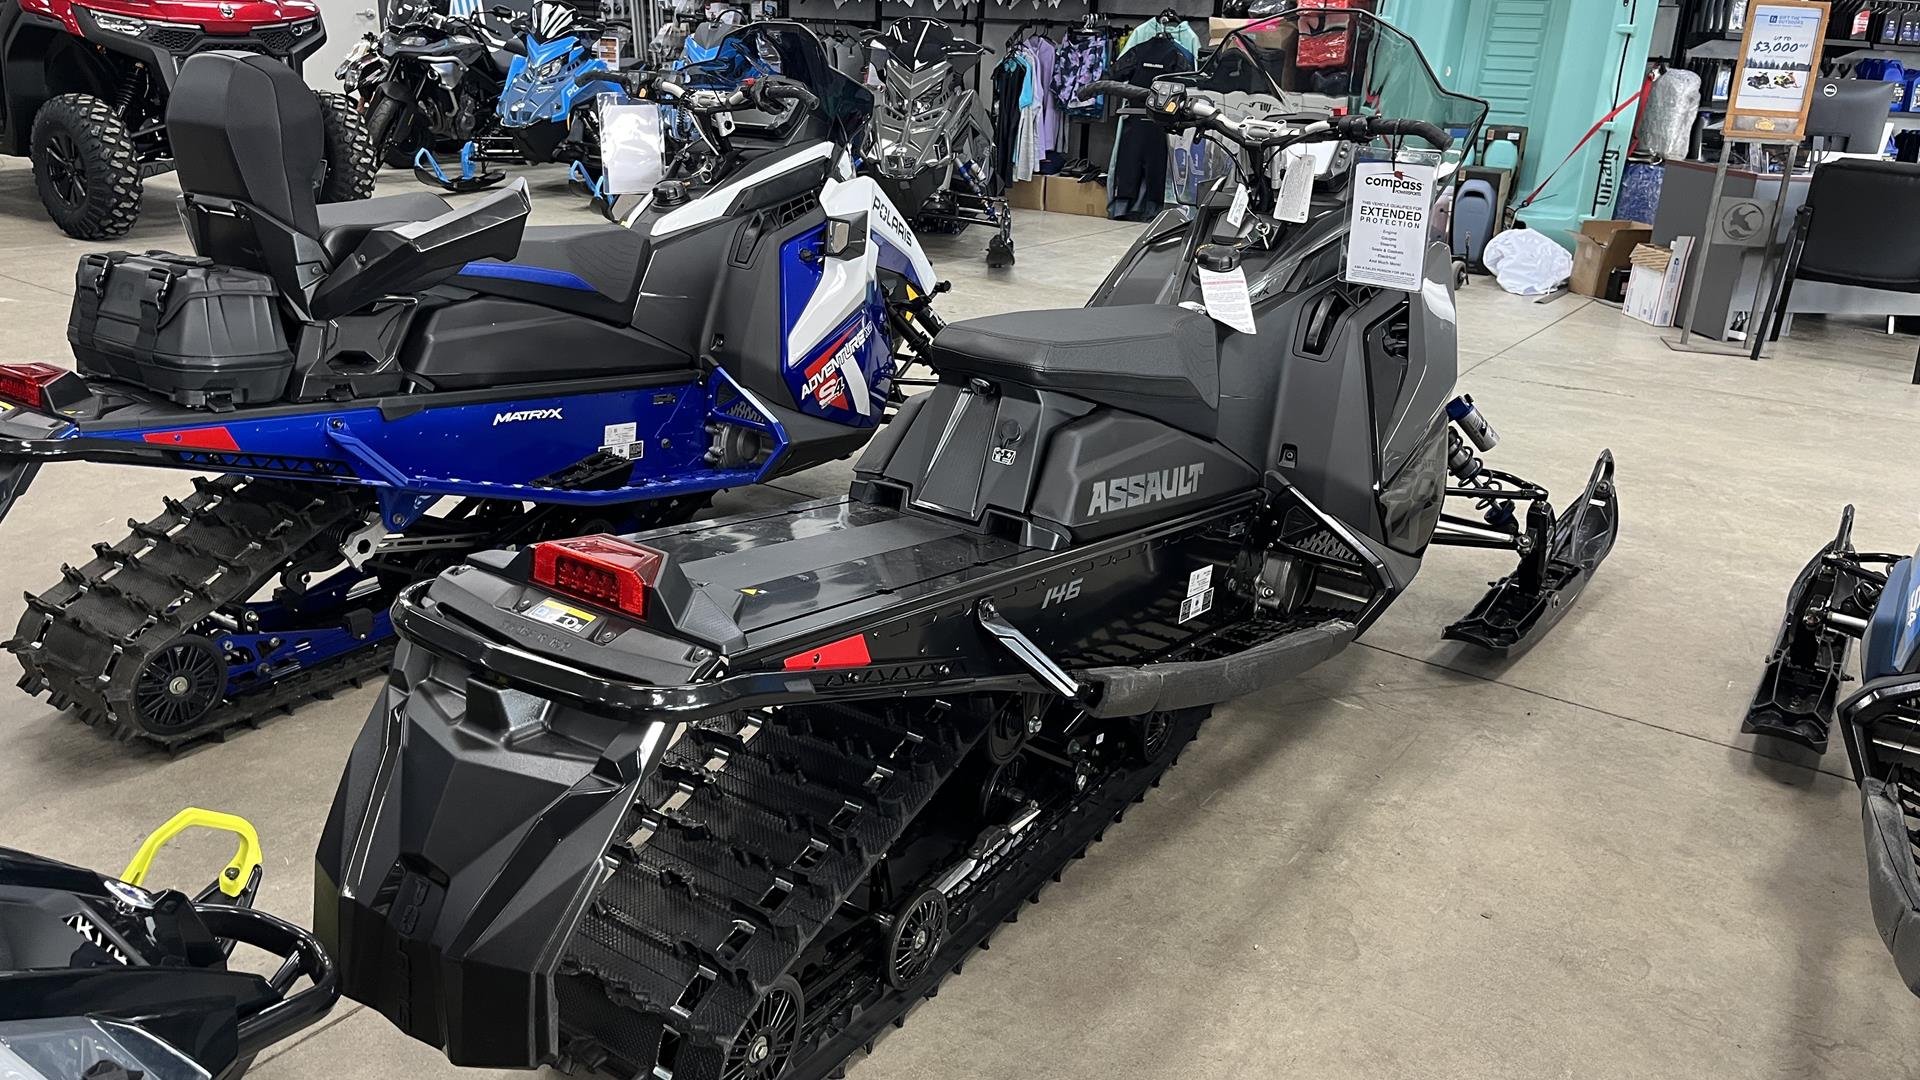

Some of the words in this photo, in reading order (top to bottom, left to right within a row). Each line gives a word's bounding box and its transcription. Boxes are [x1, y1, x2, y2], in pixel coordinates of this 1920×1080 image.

[1753, 41, 1799, 53] $3,000
[1365, 176, 1422, 193] compass
[872, 195, 912, 247] POLARIS
[1360, 205, 1422, 222] EXTENDED
[1360, 216, 1420, 229] PROTECTION
[801, 329, 867, 400] ADVENTURE
[818, 376, 845, 399] S4
[493, 407, 563, 426] MATRYX
[1087, 462, 1205, 517] ASSAULT
[1041, 577, 1084, 610] 146
